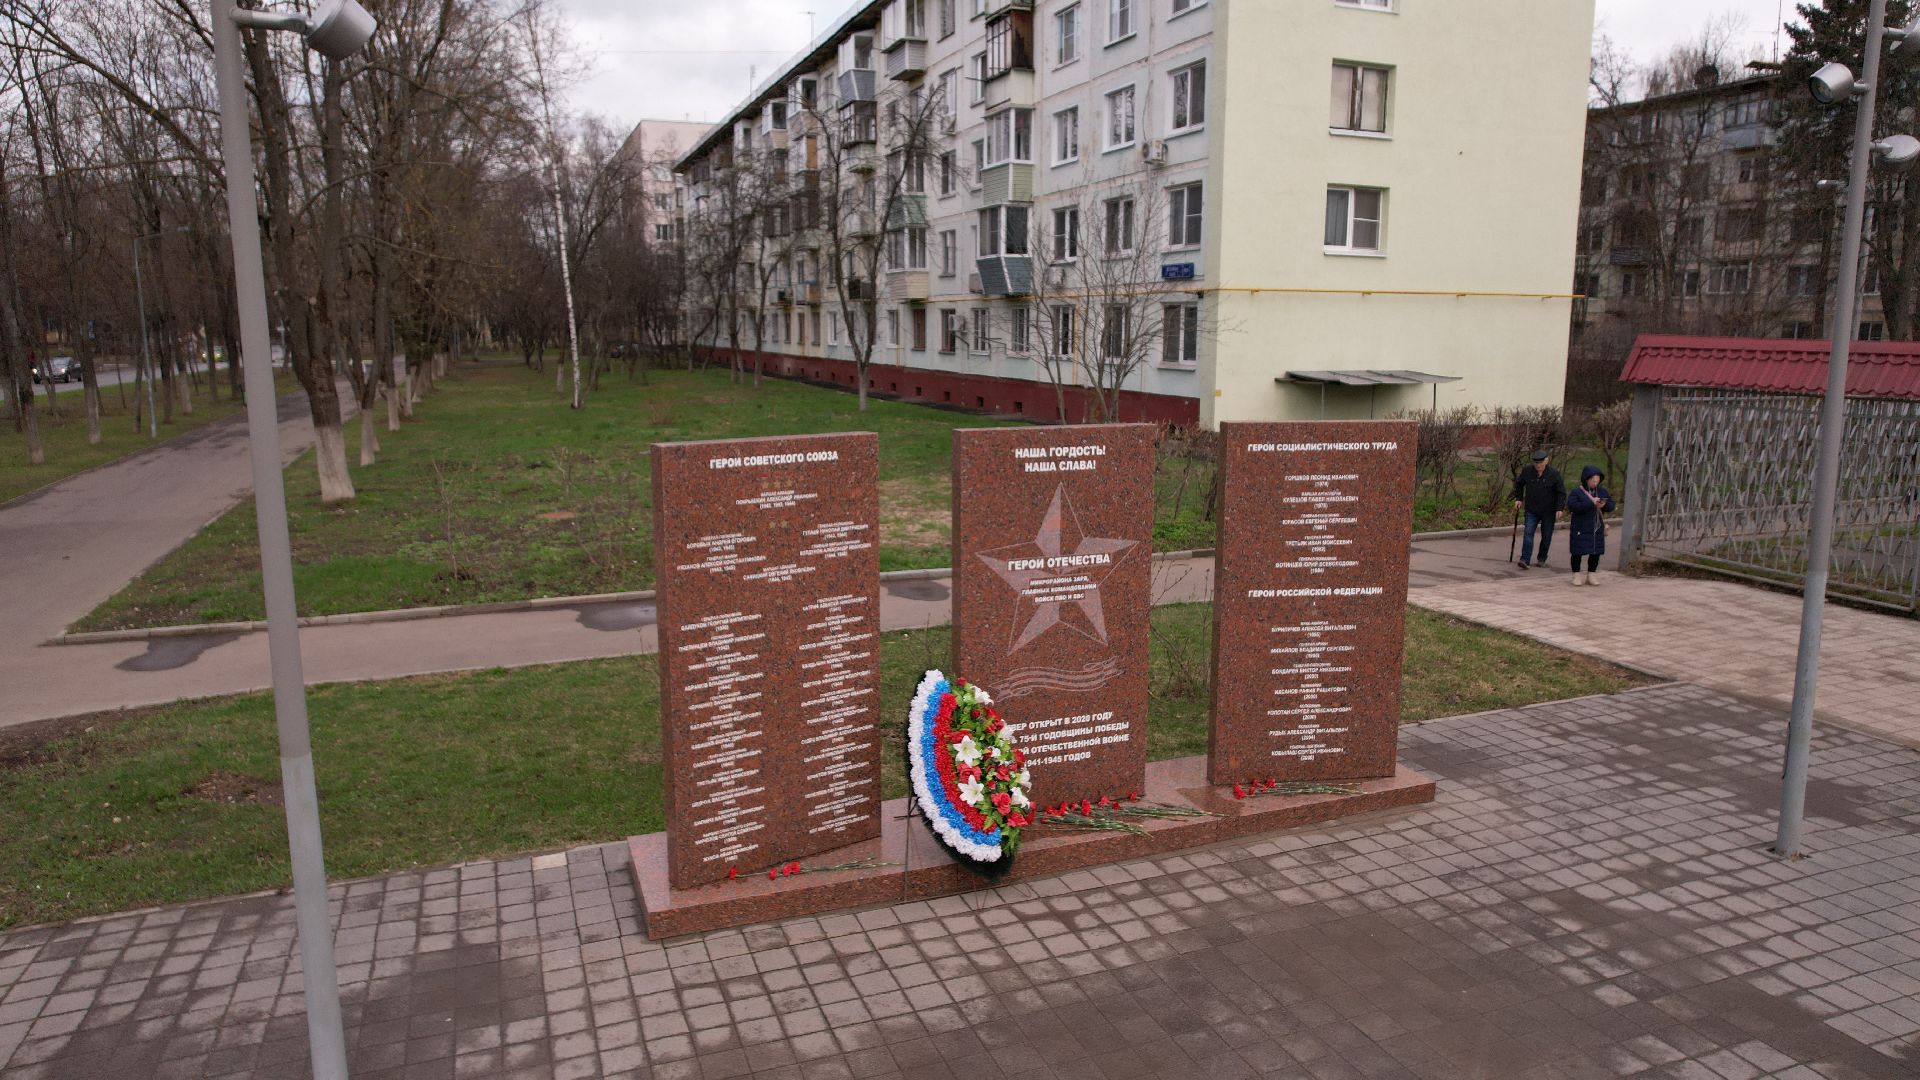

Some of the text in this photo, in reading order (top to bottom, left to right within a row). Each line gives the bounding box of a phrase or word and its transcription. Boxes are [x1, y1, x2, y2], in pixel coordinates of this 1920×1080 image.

[1015, 445, 1106, 458] НАША ГОРДОСТЬ!
[1248, 444, 1274, 452] ГЕРОИ
[1277, 443, 1369, 452] СОЦИАЛИСТИЧЕСКОГО
[710, 451, 838, 469] ГЕРОИ СОВЕТСКОГО СОЮЗА
[1025, 460, 1096, 472] НАША СЛАВА!
[1008, 554, 1110, 570] ГЕРОИ ОТЕЧЕСТВА
[1277, 587, 1331, 596] РОССИЙСКОЙ
[1334, 587, 1383, 596] ФЕДЕРАЦИИ
[1029, 718, 1062, 729] ОТКРЫТ
[1072, 715, 1090, 724] 2020
[1092, 712, 1113, 721] ГОДУ
[1039, 728, 1093, 740] ГОДОВЩИНЫ
[1095, 722, 1129, 732] ПОБЕДЫ
[1031, 737, 1100, 753] ОТЕЧЕСТВЕННОЙ
[1102, 733, 1129, 744] ВОЙНЕ
[1064, 751, 1091, 761] ГОДОВ
